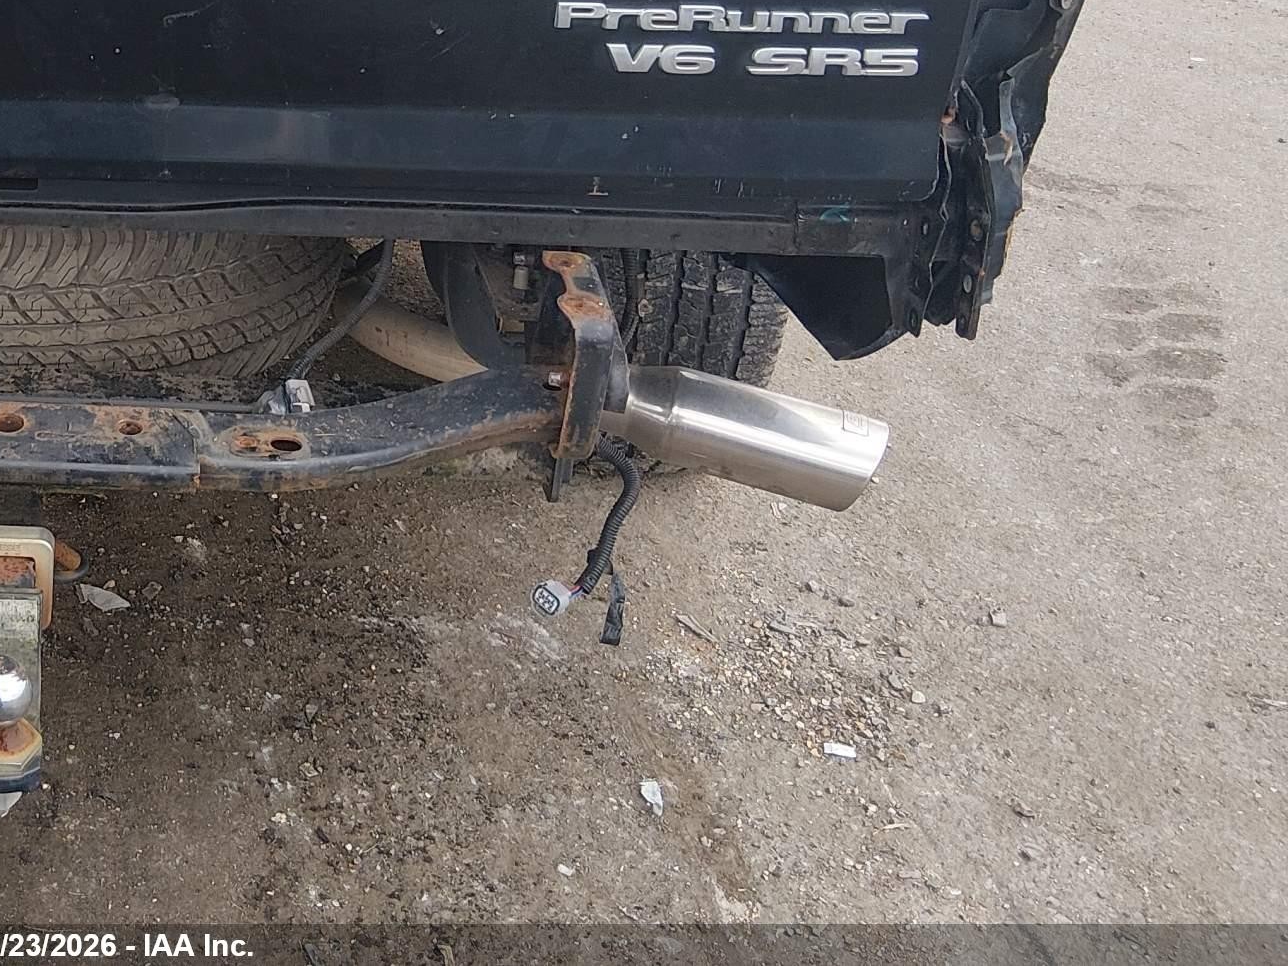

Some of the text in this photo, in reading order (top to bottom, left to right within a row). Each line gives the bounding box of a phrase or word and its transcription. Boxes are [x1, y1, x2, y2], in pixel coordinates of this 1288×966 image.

[554, 0, 930, 35] PreRunner
[605, 42, 920, 77] V6 SR5
